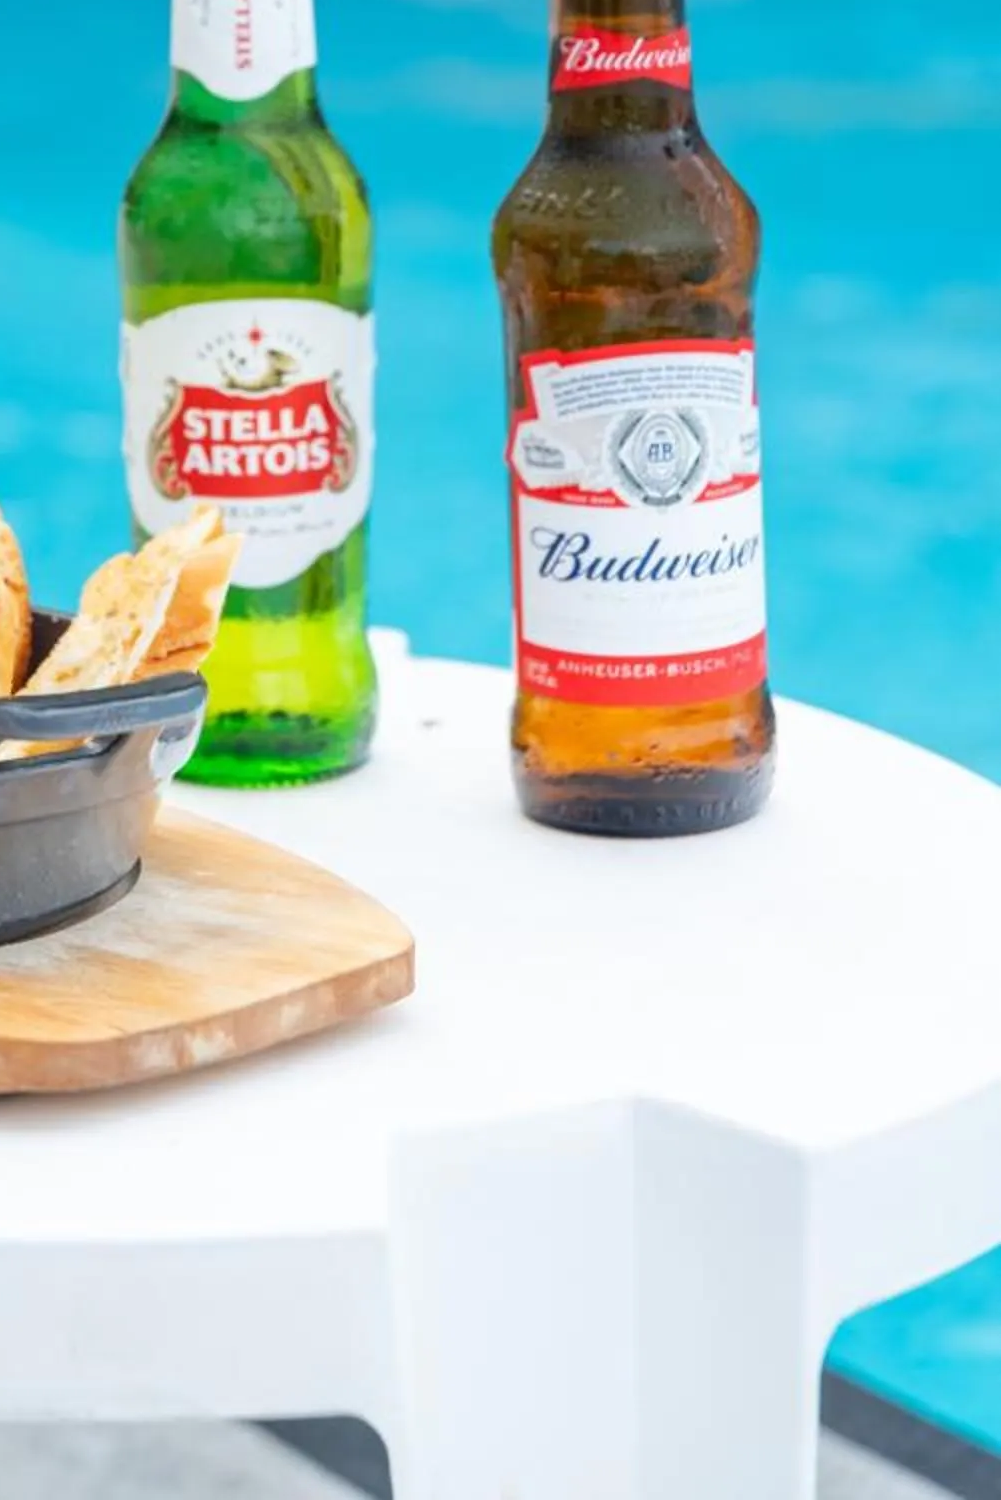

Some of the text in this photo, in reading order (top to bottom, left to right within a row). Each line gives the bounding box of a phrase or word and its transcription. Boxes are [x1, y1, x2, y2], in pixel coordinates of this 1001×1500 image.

[182, 403, 328, 440] STELLA
[182, 438, 331, 476] ARTOIS
[530, 526, 759, 582] Budweiser
